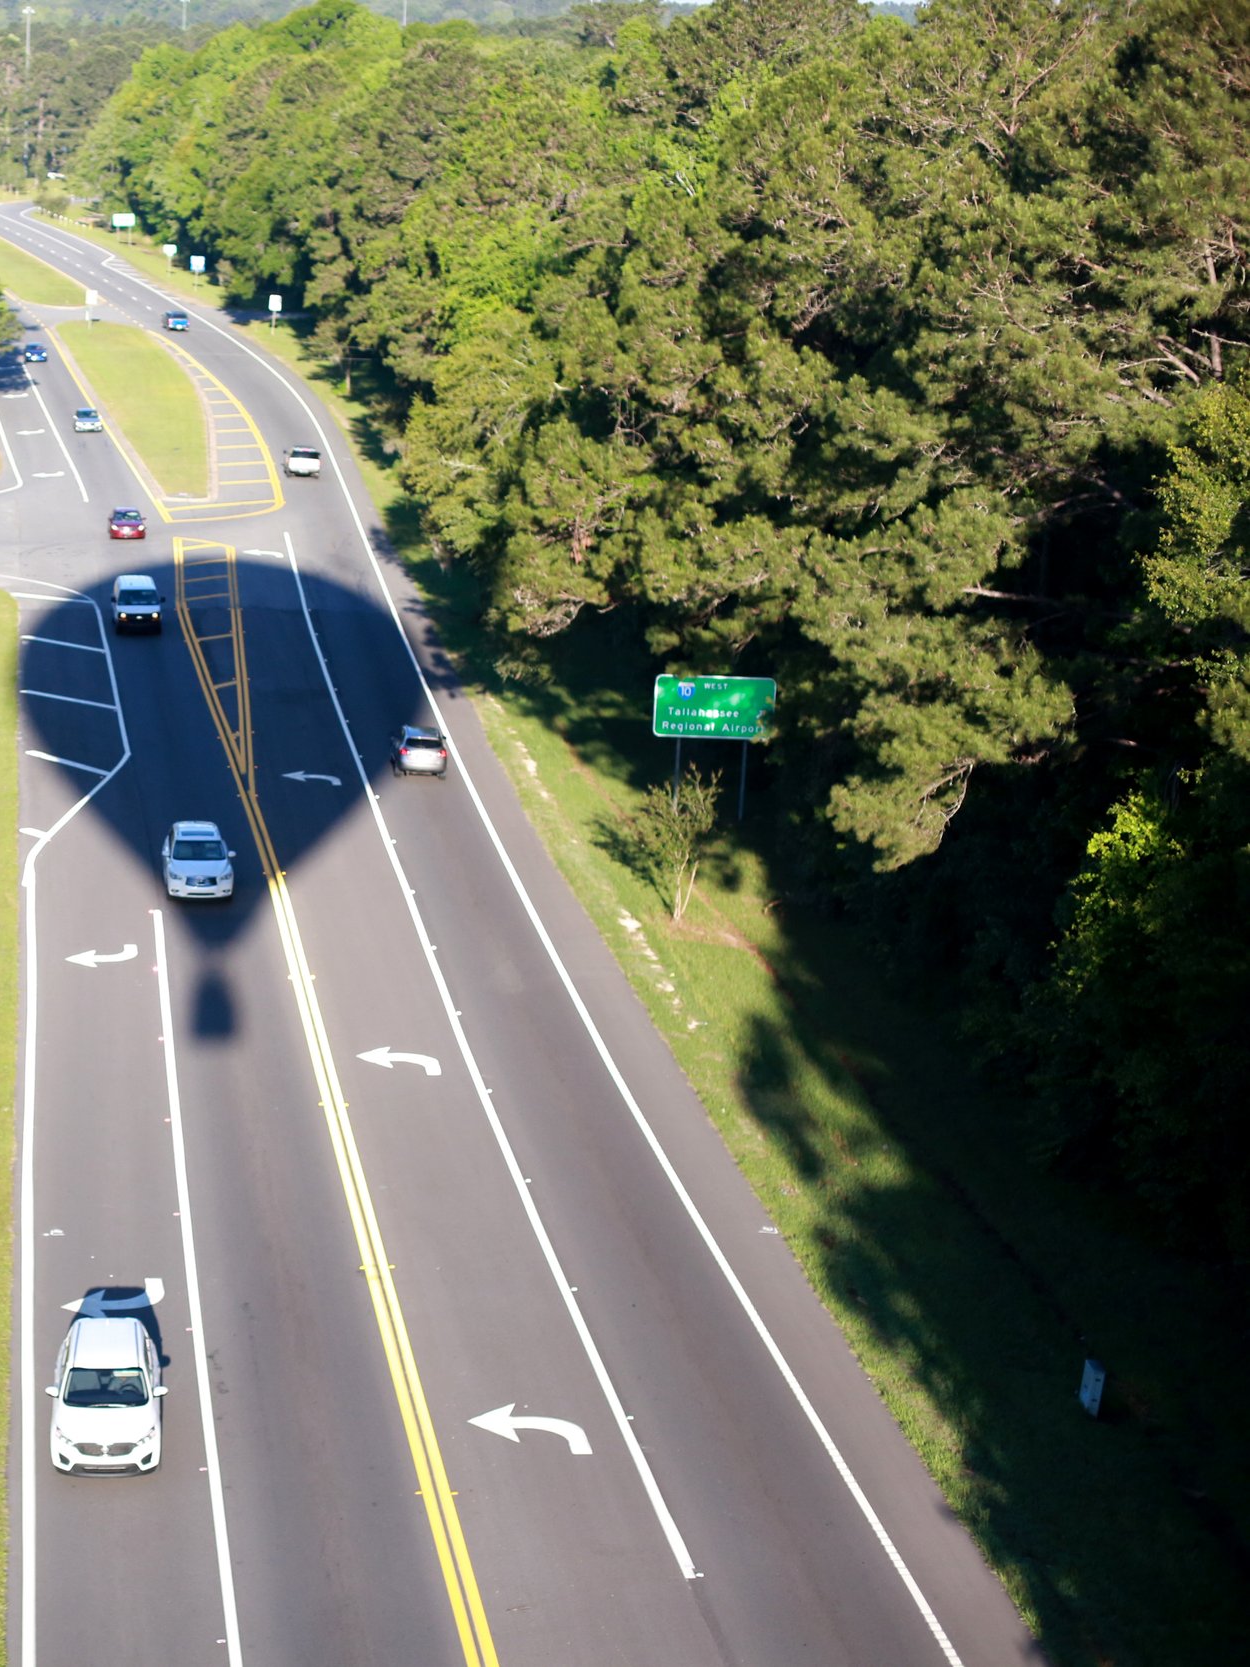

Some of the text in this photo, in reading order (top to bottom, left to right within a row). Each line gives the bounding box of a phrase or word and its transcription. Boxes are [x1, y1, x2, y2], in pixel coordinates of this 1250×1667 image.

[681, 686, 692, 697] 10
[668, 706, 740, 718] Tallahassee
[662, 721, 715, 733] Regional
